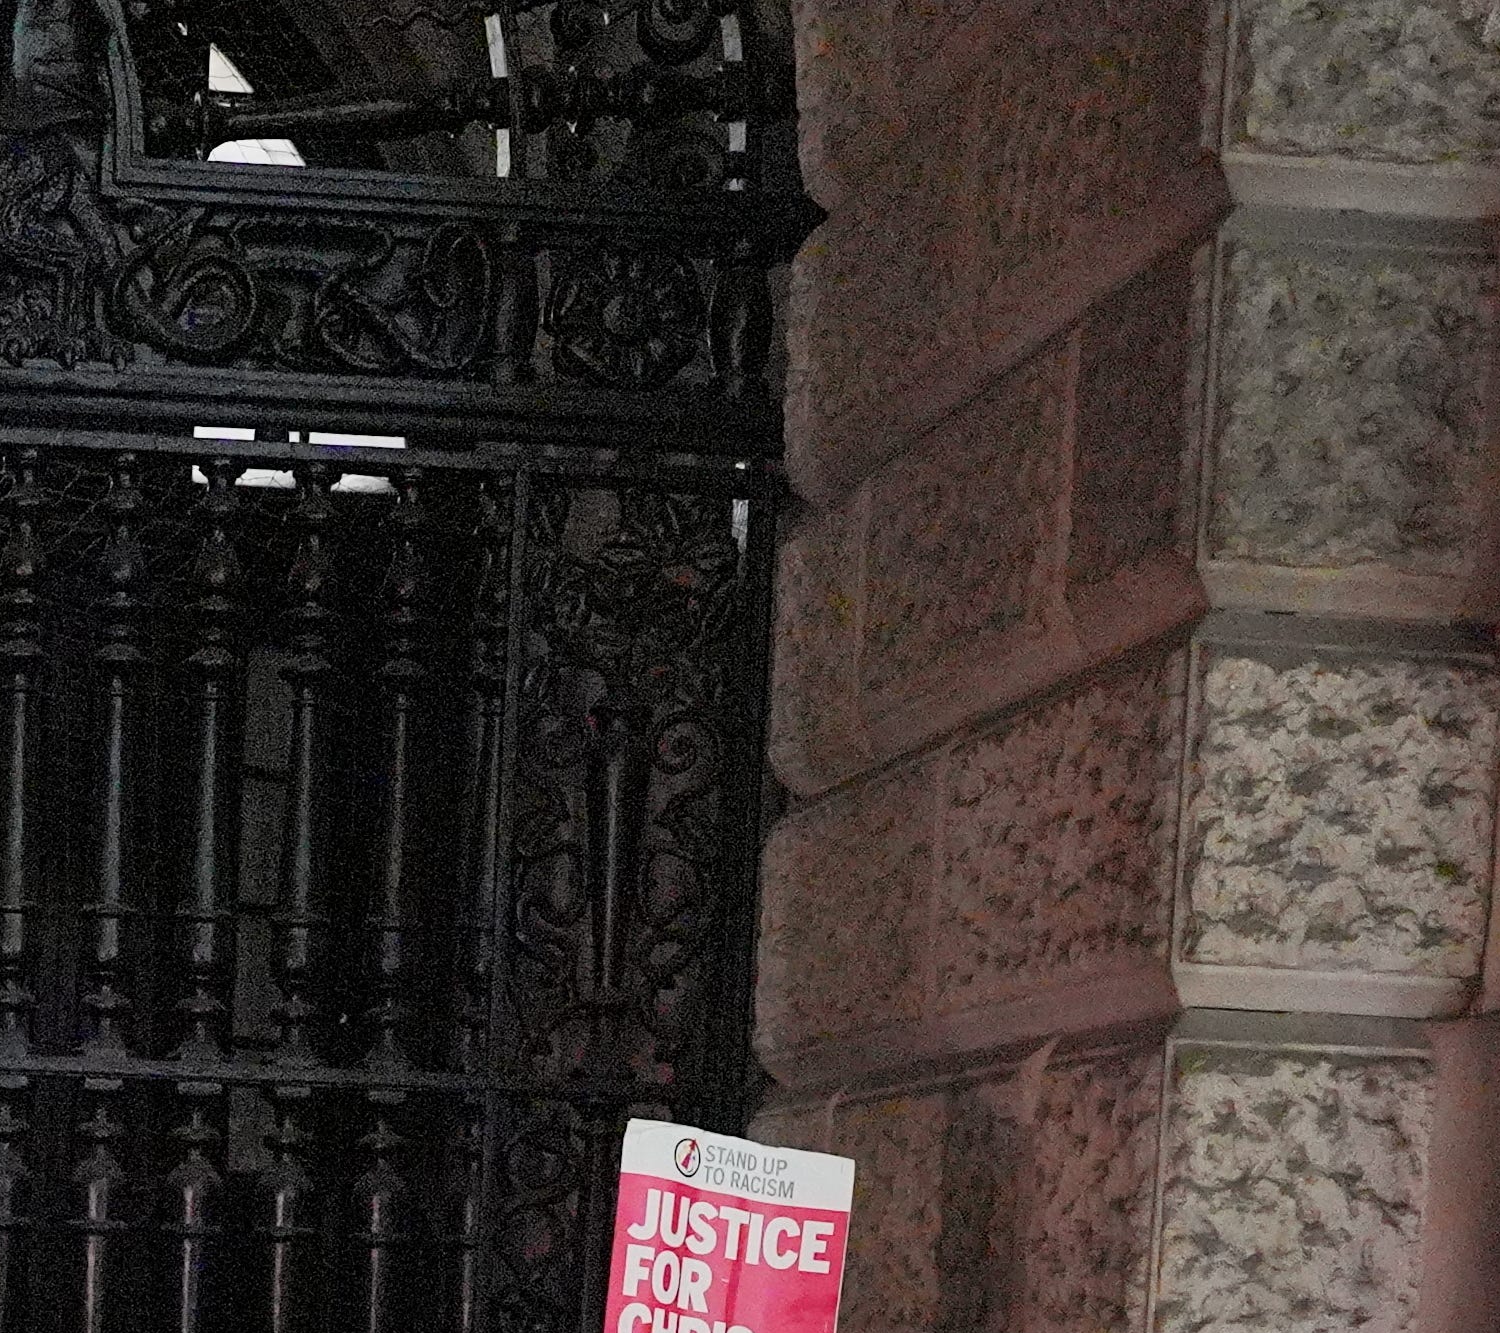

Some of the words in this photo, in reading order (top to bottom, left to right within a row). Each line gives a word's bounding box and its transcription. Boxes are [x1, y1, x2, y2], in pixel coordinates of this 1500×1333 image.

[703, 1165, 725, 1186] TO
[730, 1171, 795, 1199] RACISM
[706, 1145, 757, 1172] STAND
[763, 1157, 788, 1177] UP
[627, 1188, 835, 1274] JUSTICE
[622, 1245, 713, 1313] FOR
